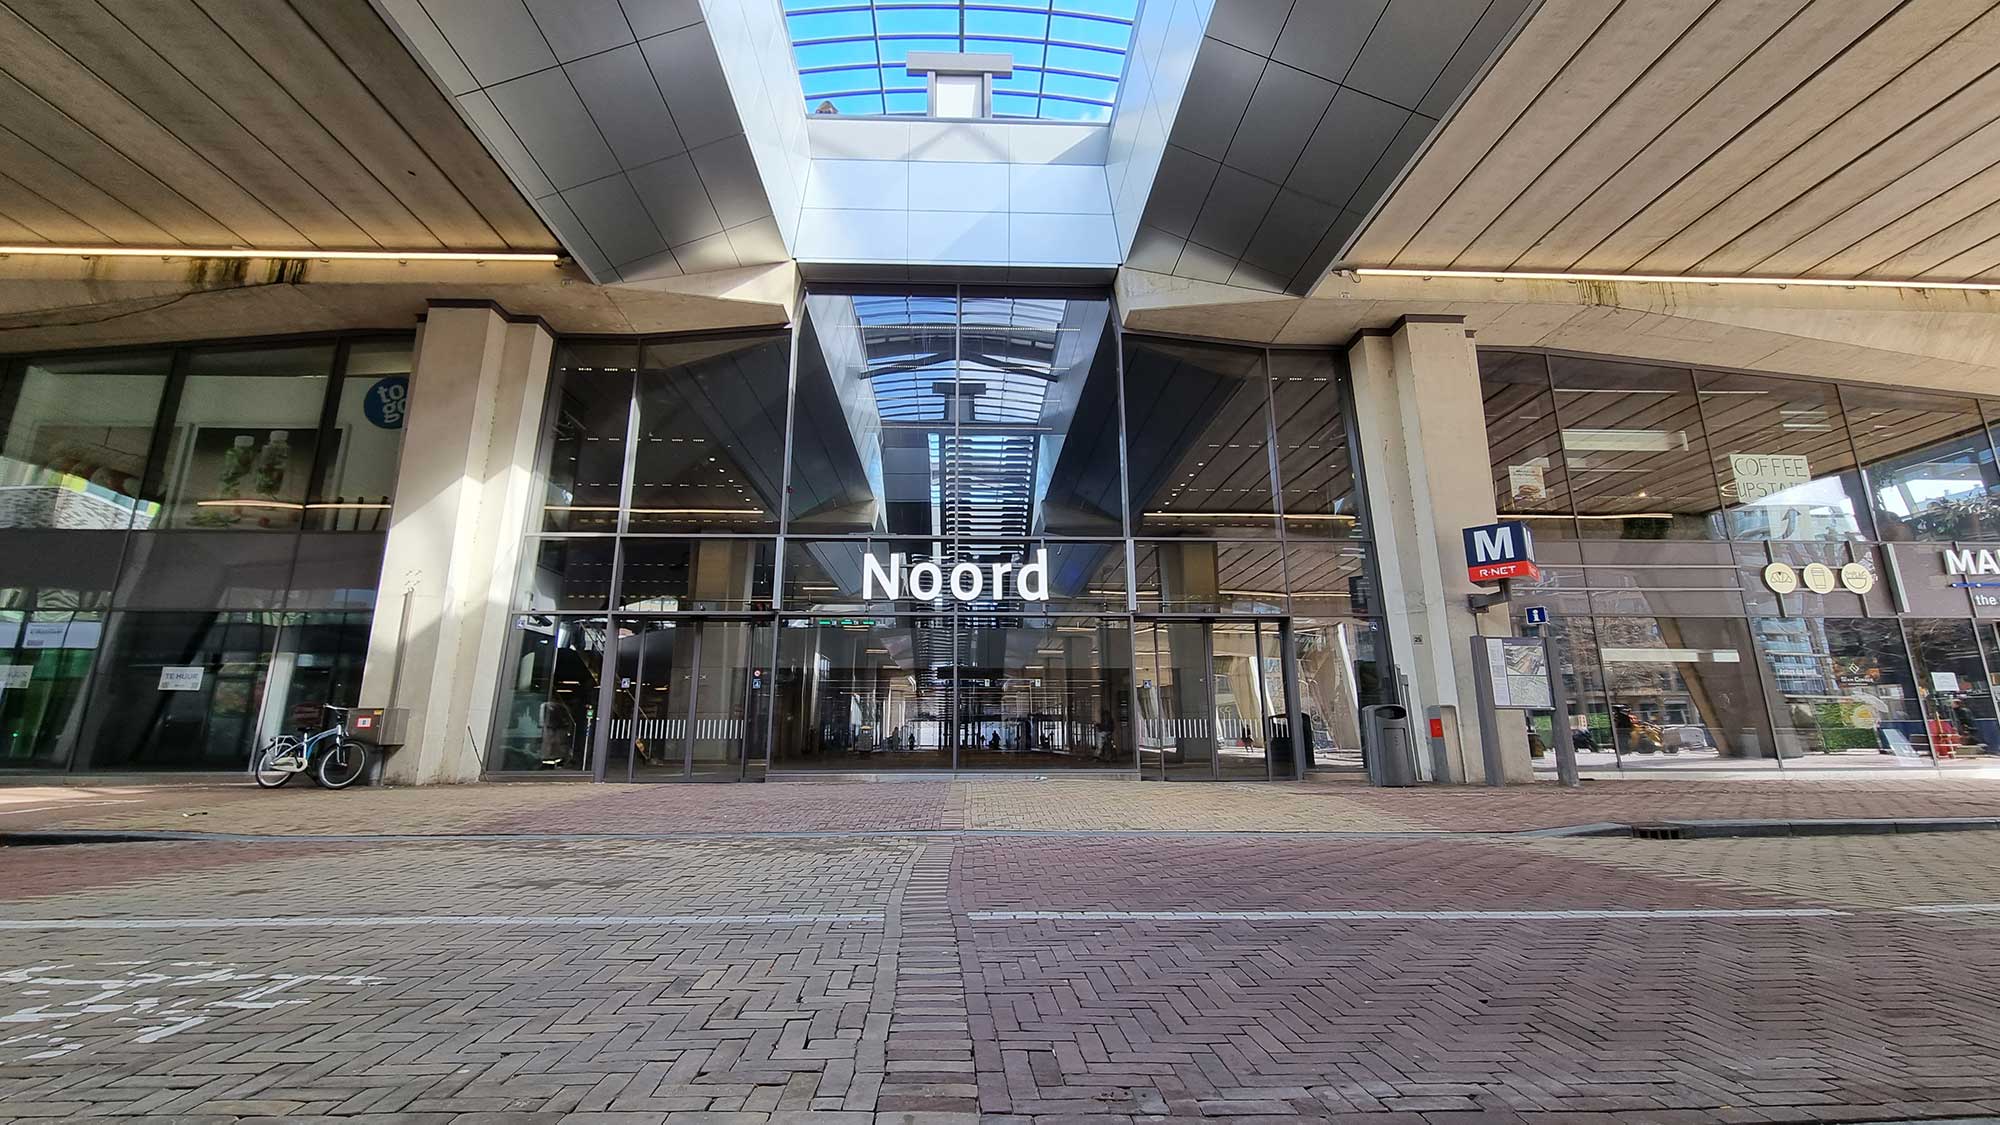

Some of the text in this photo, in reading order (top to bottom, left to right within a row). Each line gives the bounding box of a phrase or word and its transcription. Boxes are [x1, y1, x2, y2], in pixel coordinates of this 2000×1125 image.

[377, 385, 405, 403] to
[1734, 458, 1807, 477] COFFEE
[1473, 526, 1515, 562] M
[1943, 548, 2000, 576] MA
[863, 549, 1049, 601] Noord
[1975, 594, 1998, 606] the
